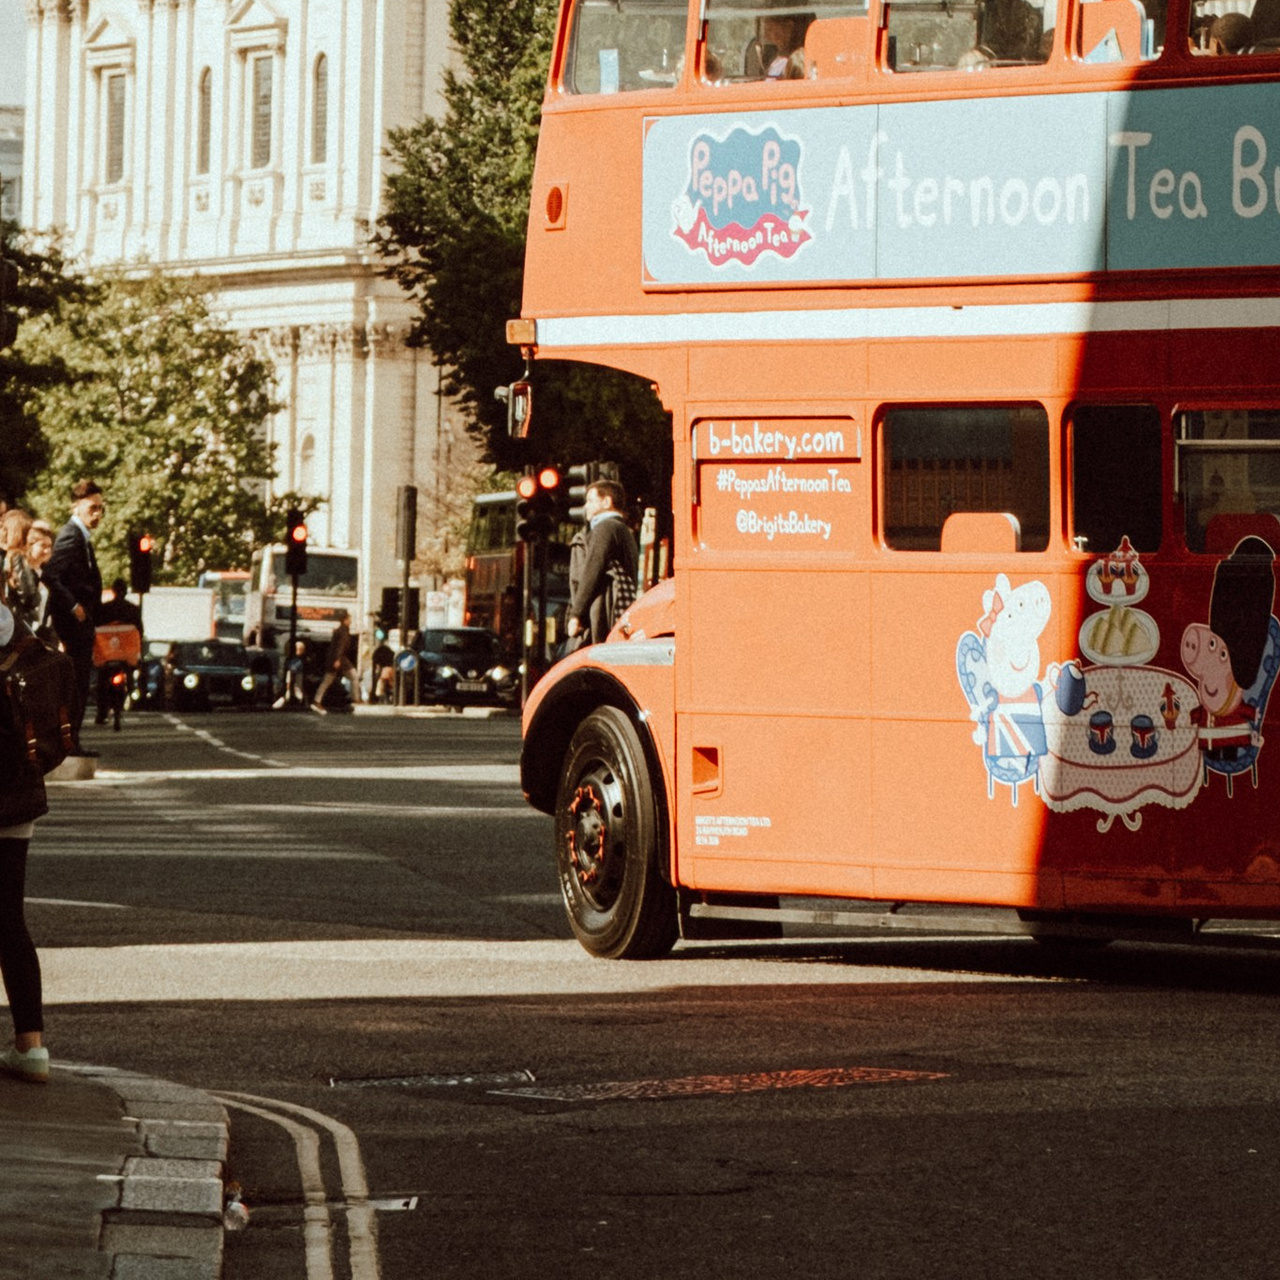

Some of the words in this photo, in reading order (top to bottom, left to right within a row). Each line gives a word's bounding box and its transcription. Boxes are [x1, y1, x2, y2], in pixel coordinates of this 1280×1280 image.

[692, 140, 759, 217] Peppa
[762, 140, 797, 208] Pig
[825, 131, 1091, 230] Afternoon
[1110, 132, 1208, 221] Tea
[698, 222, 763, 258] Afternoon
[764, 222, 789, 247] Tea
[709, 421, 845, 460] b-bakery.com
[716, 466, 852, 500] #PeppasAfternoonTea
[736, 509, 832, 540] @BrigitsBakery
